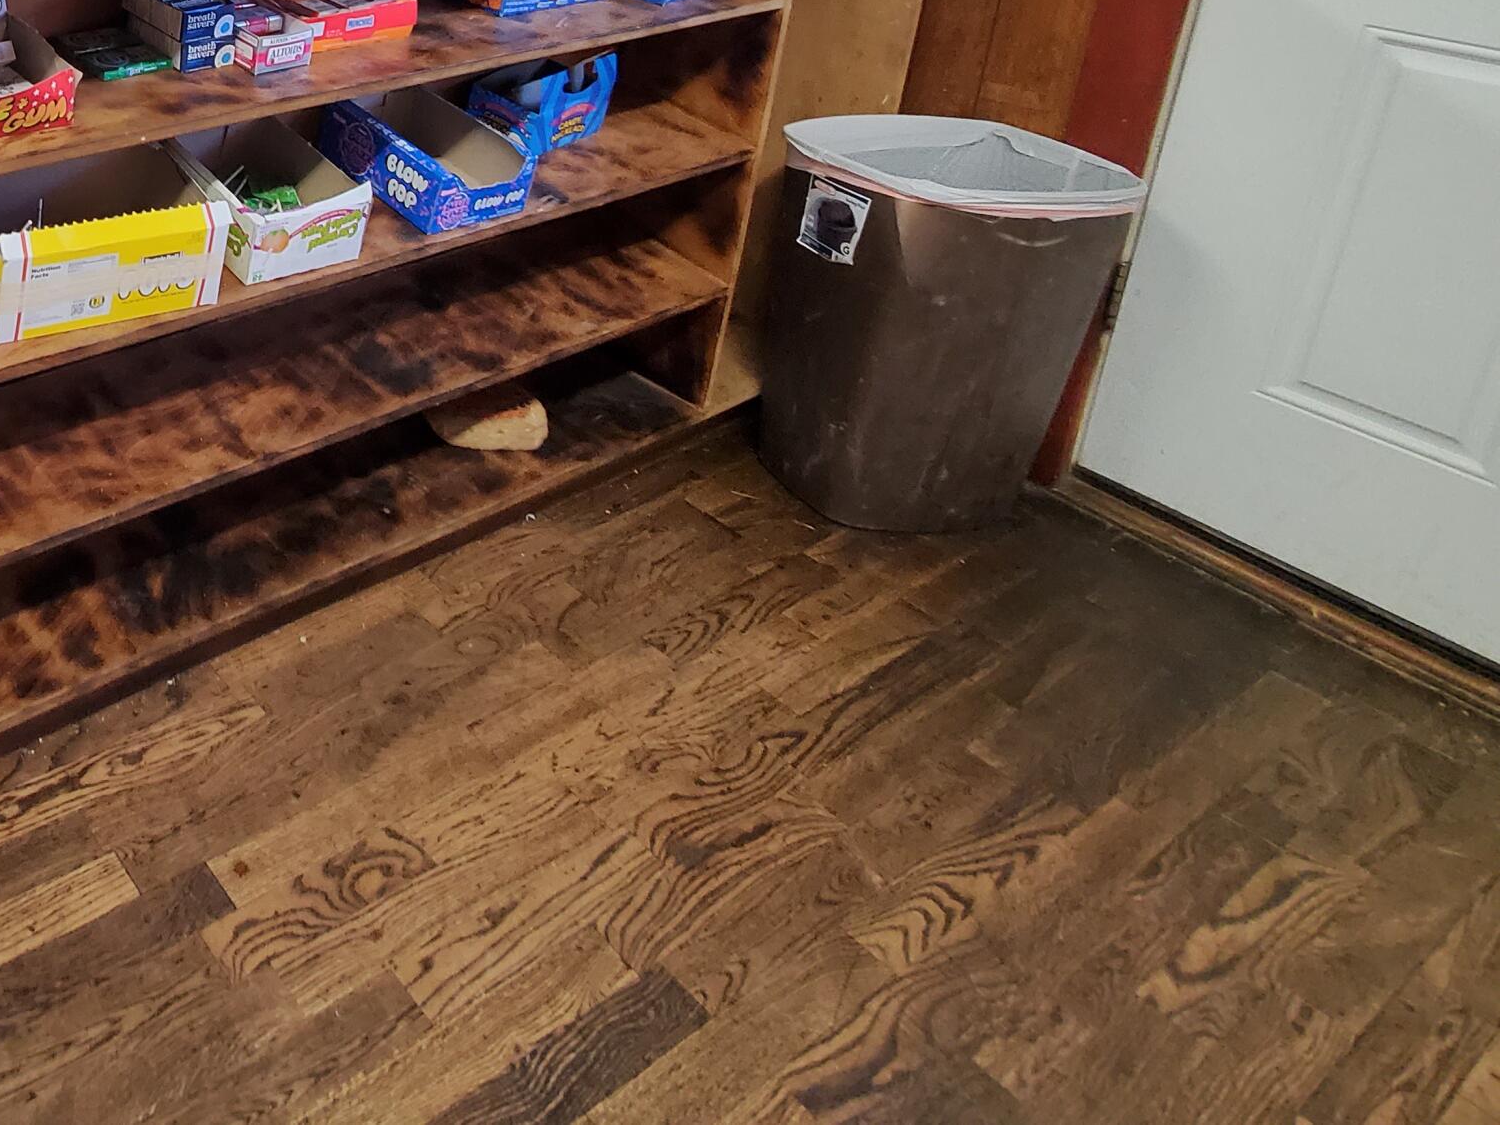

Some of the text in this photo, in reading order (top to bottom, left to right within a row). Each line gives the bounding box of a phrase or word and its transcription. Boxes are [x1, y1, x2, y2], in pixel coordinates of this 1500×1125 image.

[186, 11, 217, 24] breath
[186, 20, 217, 32] savers
[186, 41, 218, 54] breath
[186, 49, 217, 62] savers
[268, 43, 303, 61] ALTOIDS
[2, 94, 69, 135] GUM
[385, 153, 430, 194] BLOW
[386, 178, 418, 210] POP
[504, 188, 527, 206] POP
